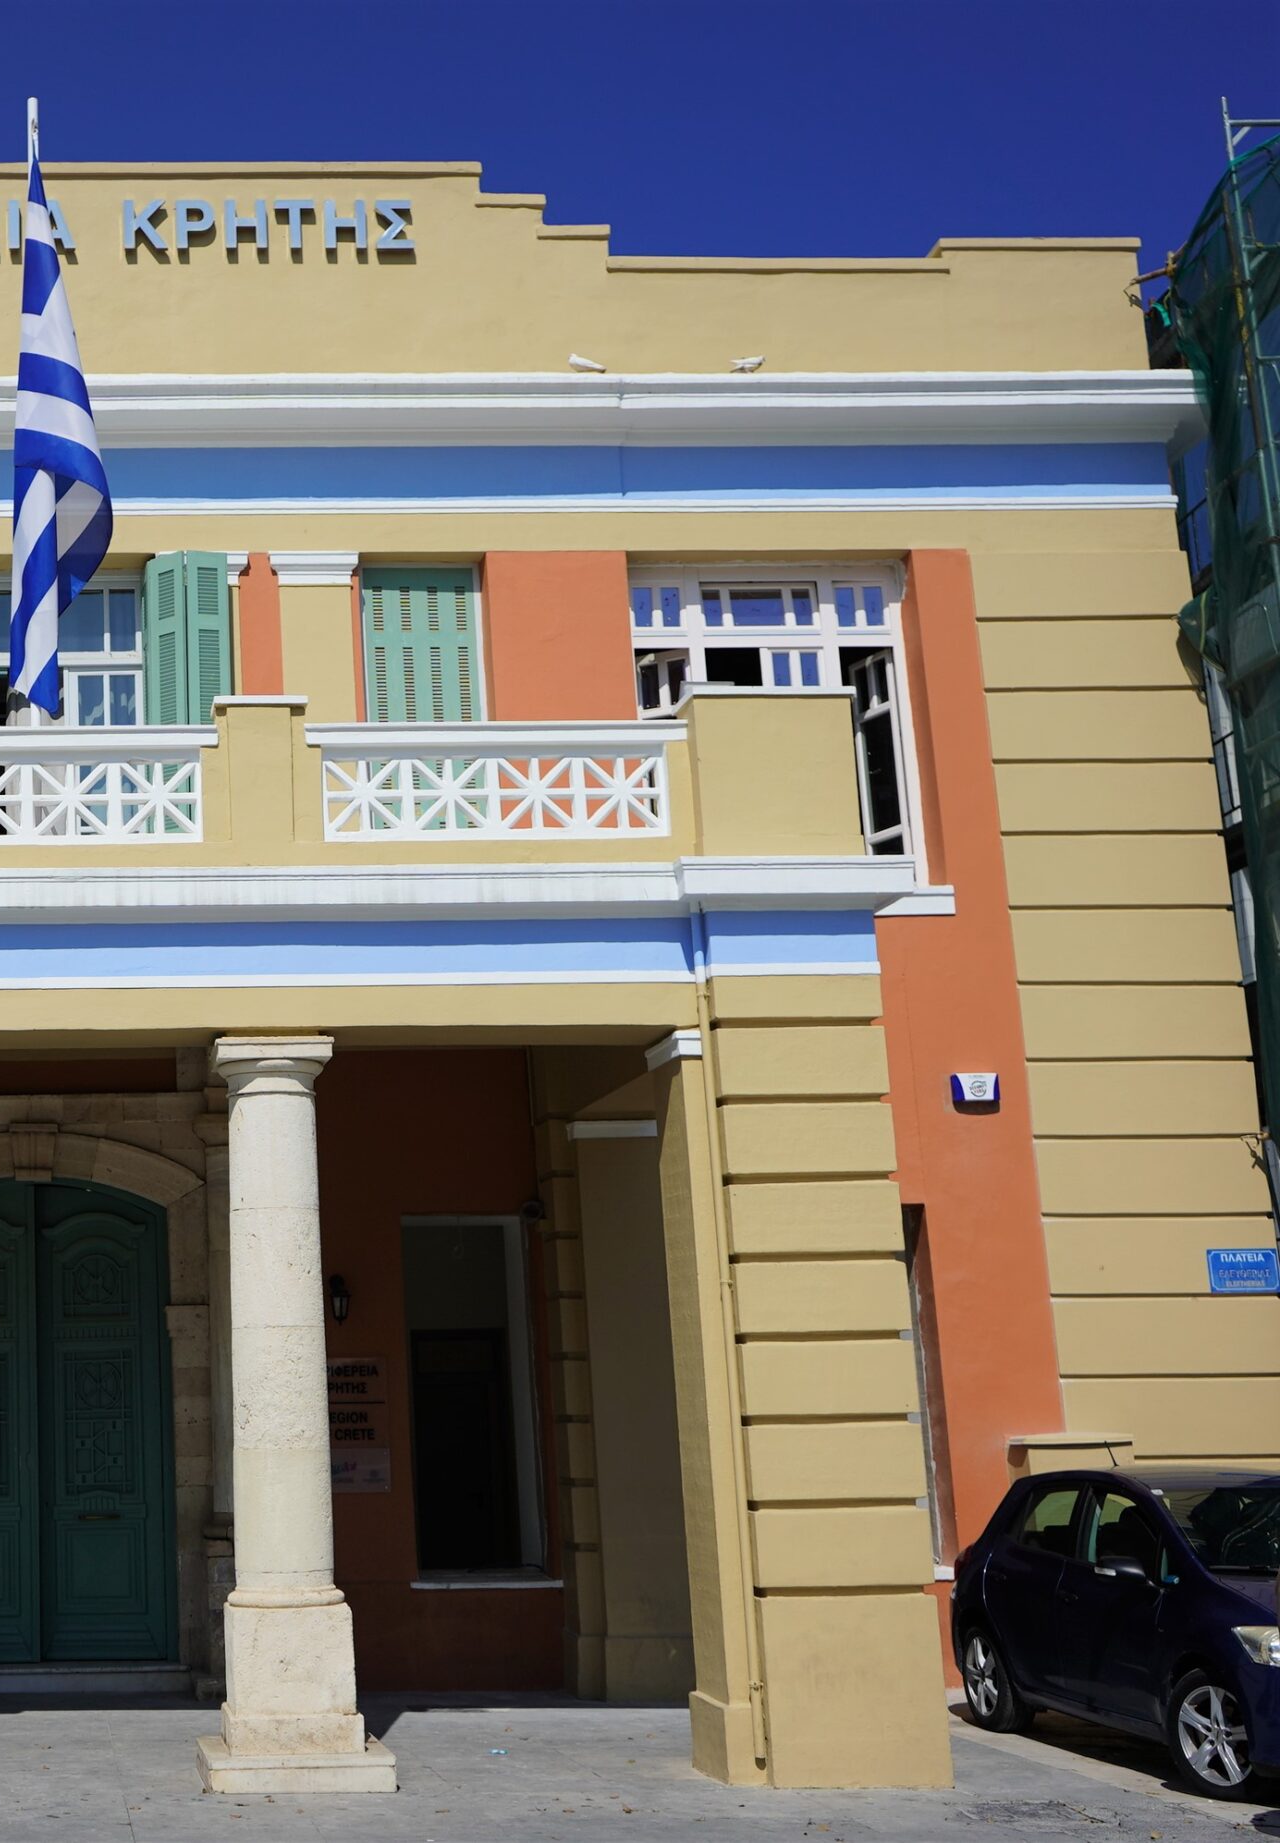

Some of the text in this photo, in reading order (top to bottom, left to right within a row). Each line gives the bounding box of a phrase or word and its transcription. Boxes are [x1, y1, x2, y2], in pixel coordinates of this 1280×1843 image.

[122, 199, 416, 250] ΚΡΗΤΗΣ
[1220, 1253, 1265, 1263] ΠΛΑΤΕΙΑ
[327, 1364, 379, 1377] ΙΦΕΡΕΙΑ
[328, 1382, 368, 1394] ΡΗΤΗΣ
[329, 1412, 368, 1424] EGION
[334, 1428, 376, 1440] CRETE
